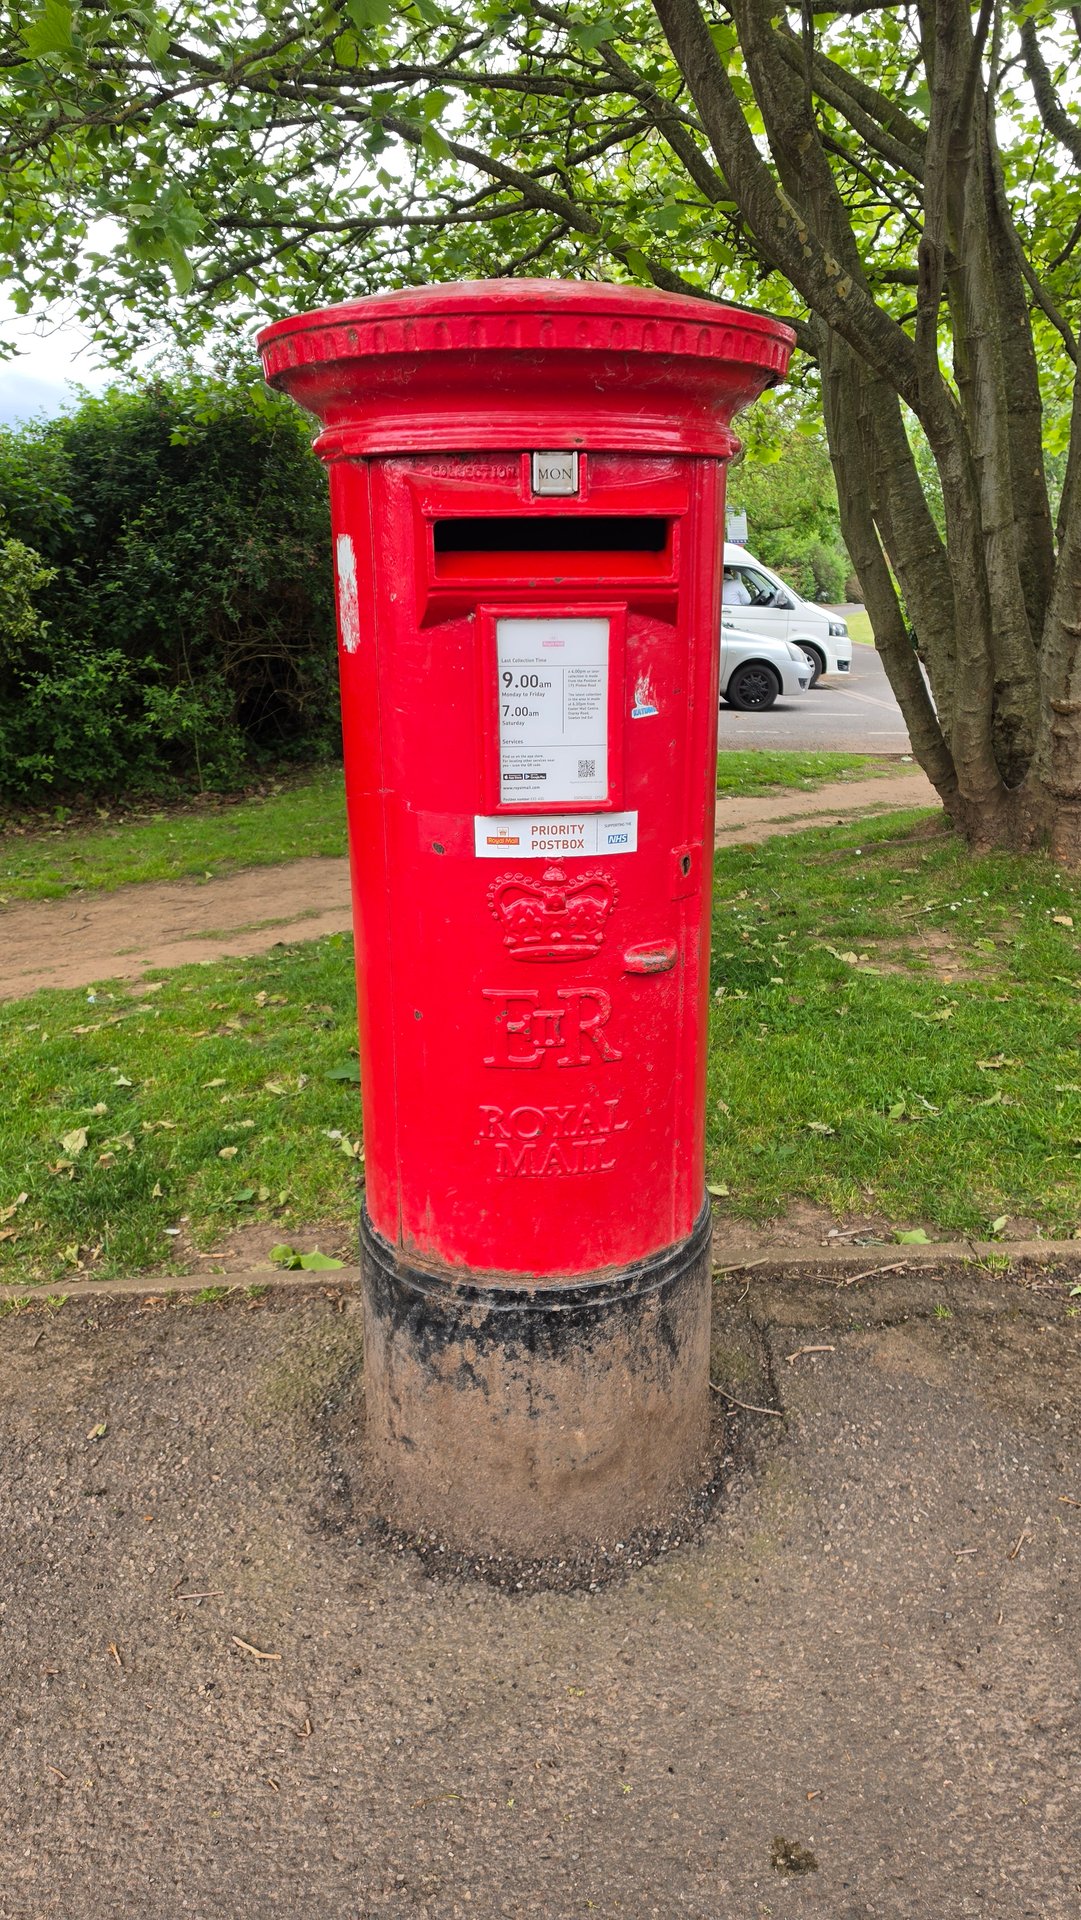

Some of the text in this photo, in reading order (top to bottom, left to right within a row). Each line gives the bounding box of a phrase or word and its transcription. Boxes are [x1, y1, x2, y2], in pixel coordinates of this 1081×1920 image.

[537, 468, 572, 480] MON
[502, 672, 552, 688] 9.00am
[502, 705, 540, 717] 7.00am
[531, 824, 584, 836] PRIORITY
[532, 839, 584, 850] POSTBOX
[608, 835, 627, 843] NHS
[479, 1099, 628, 1139] ROYAL
[495, 1138, 616, 1177] MAIL
